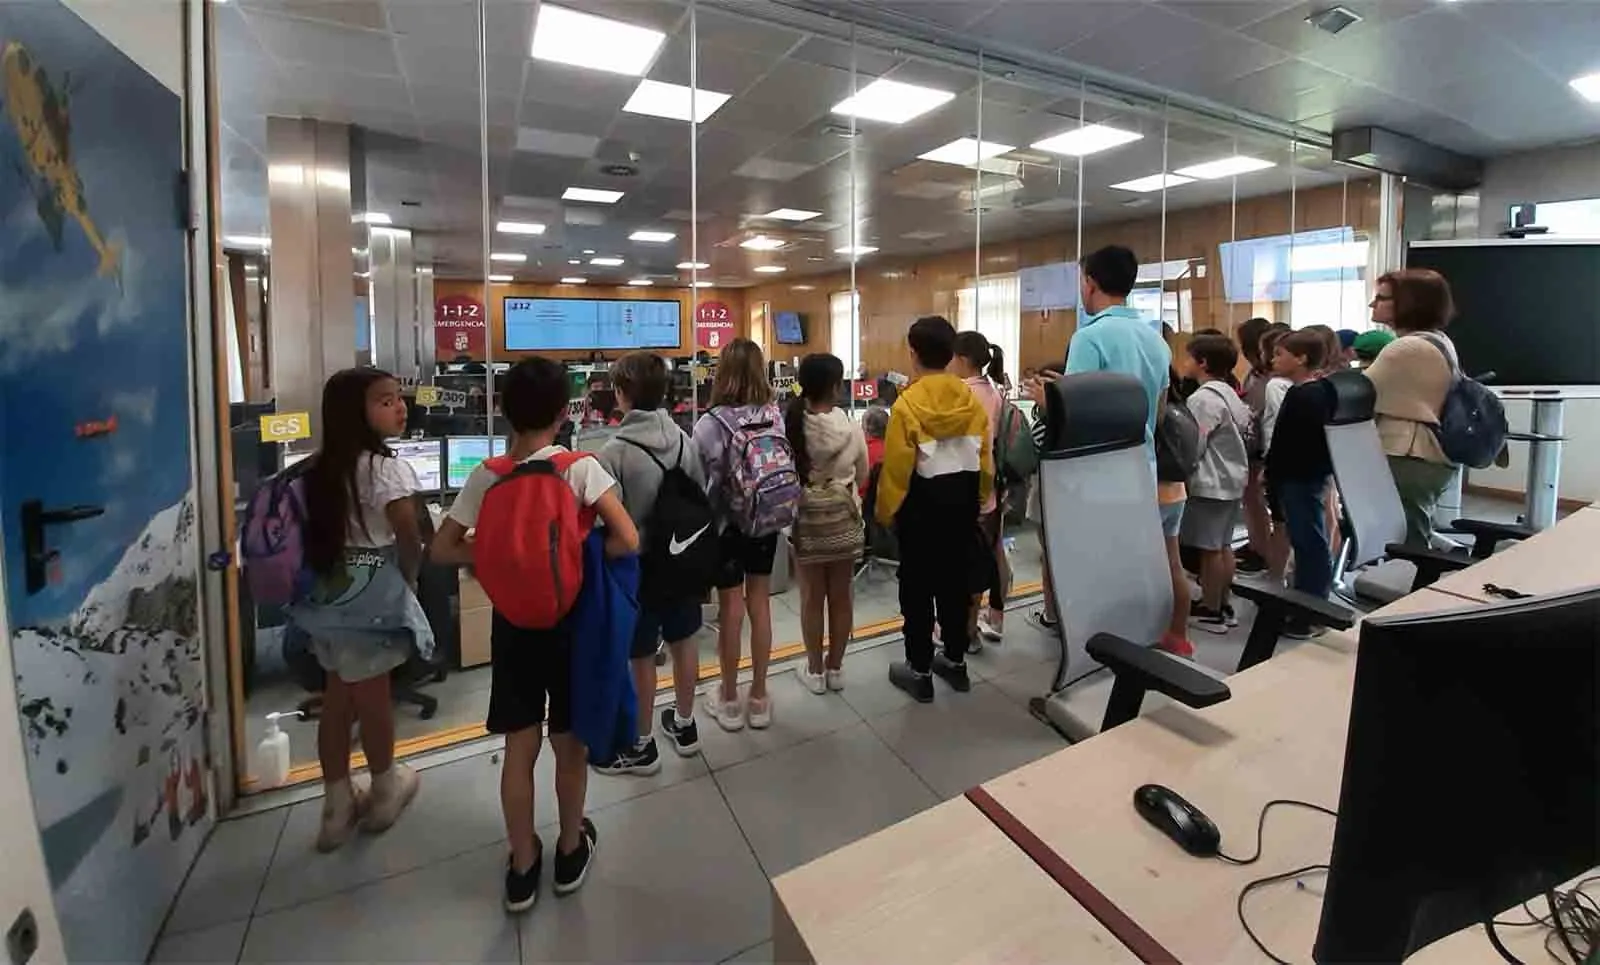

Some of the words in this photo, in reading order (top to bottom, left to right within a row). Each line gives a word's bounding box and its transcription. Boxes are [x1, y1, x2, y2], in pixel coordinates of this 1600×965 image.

[442, 305, 479, 317] 1-1-2
[701, 308, 727, 318] 1-1-2
[857, 384, 873, 396] JS
[437, 391, 465, 403] 7309
[270, 419, 300, 434] GS
